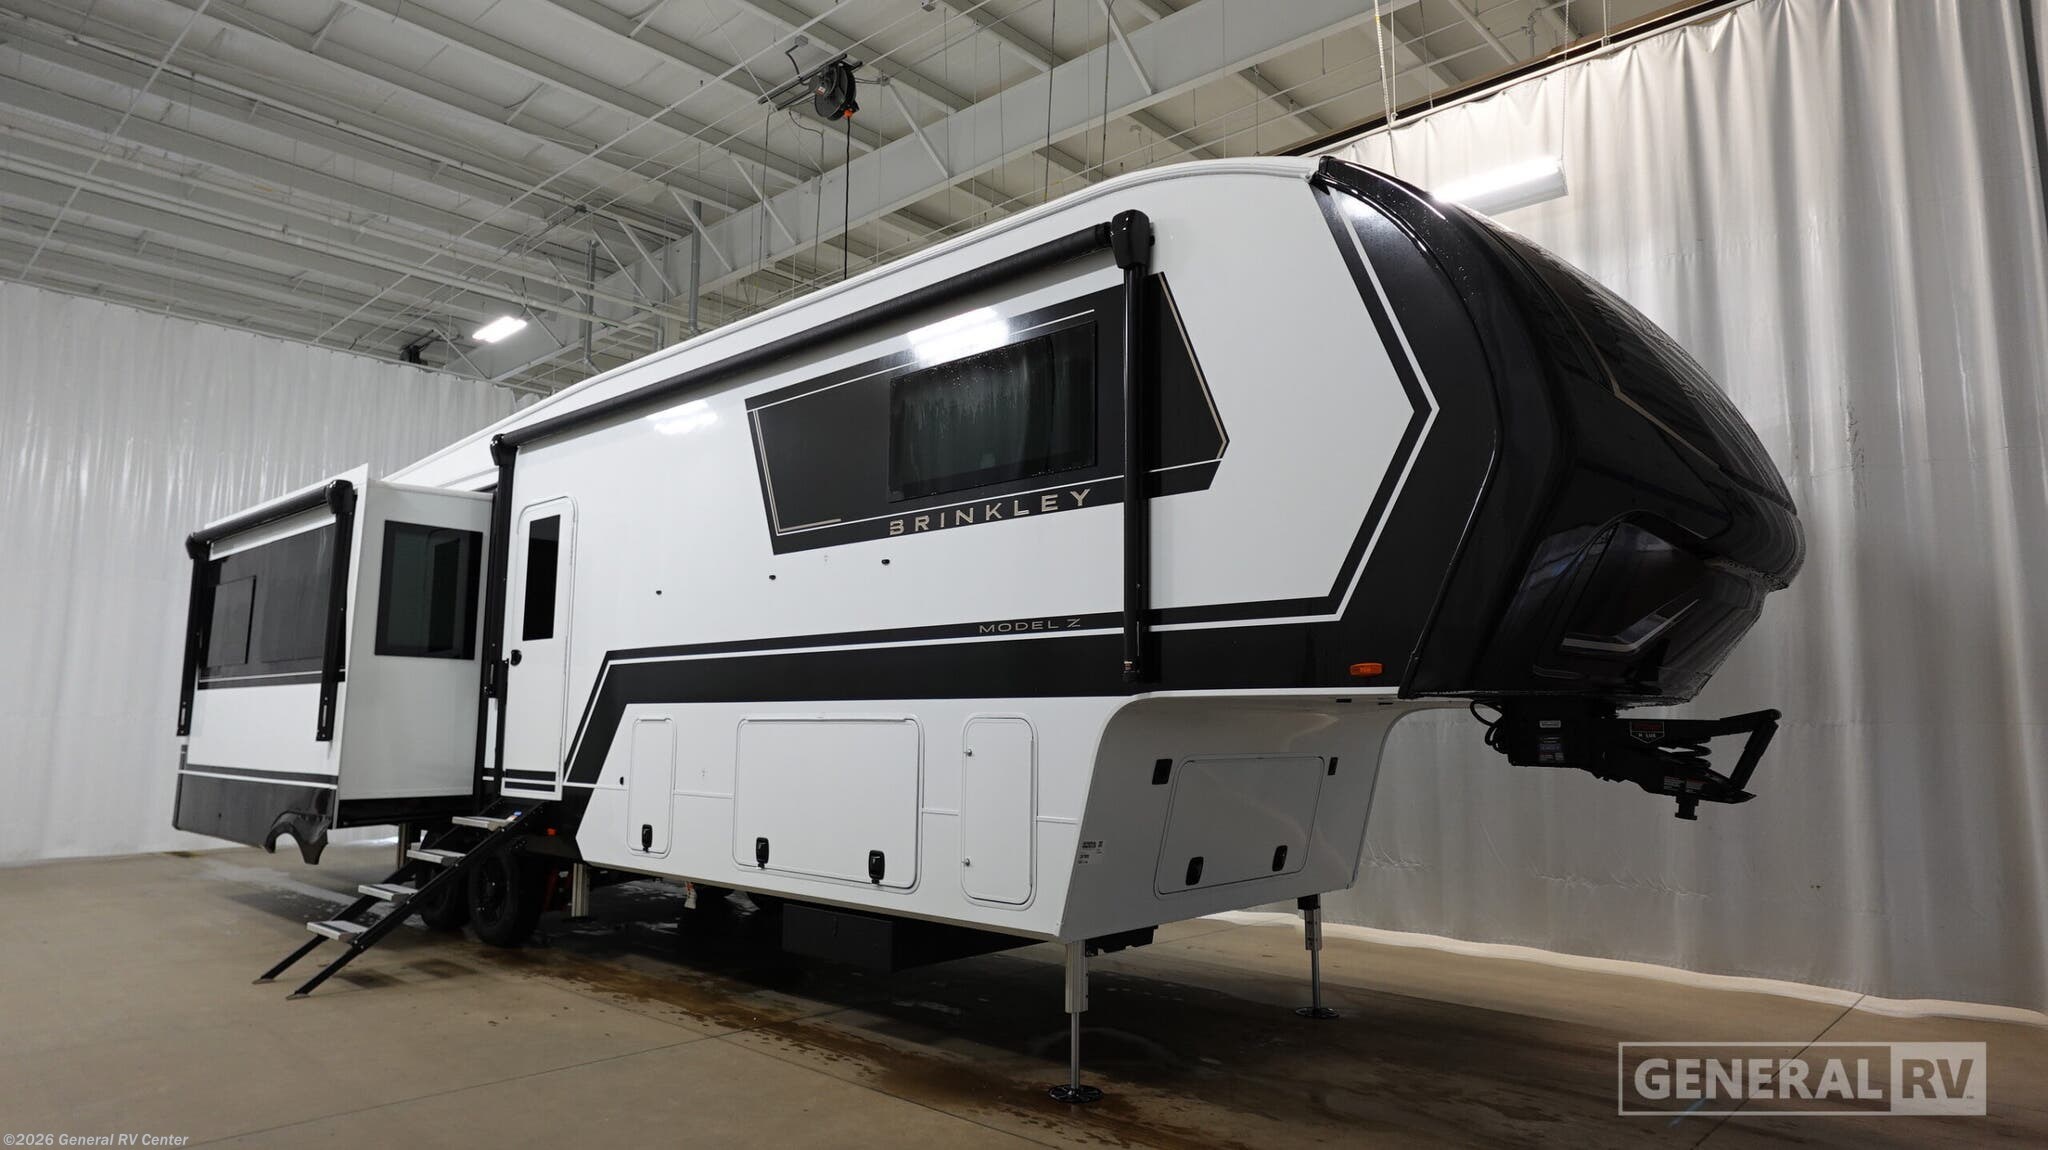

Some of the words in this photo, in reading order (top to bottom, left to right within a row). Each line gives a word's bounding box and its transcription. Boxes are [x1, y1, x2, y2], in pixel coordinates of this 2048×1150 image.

[889, 488, 1090, 536] BRINKLEY
[979, 619, 1059, 634] MODEL
[1067, 618, 1081, 628] Z
